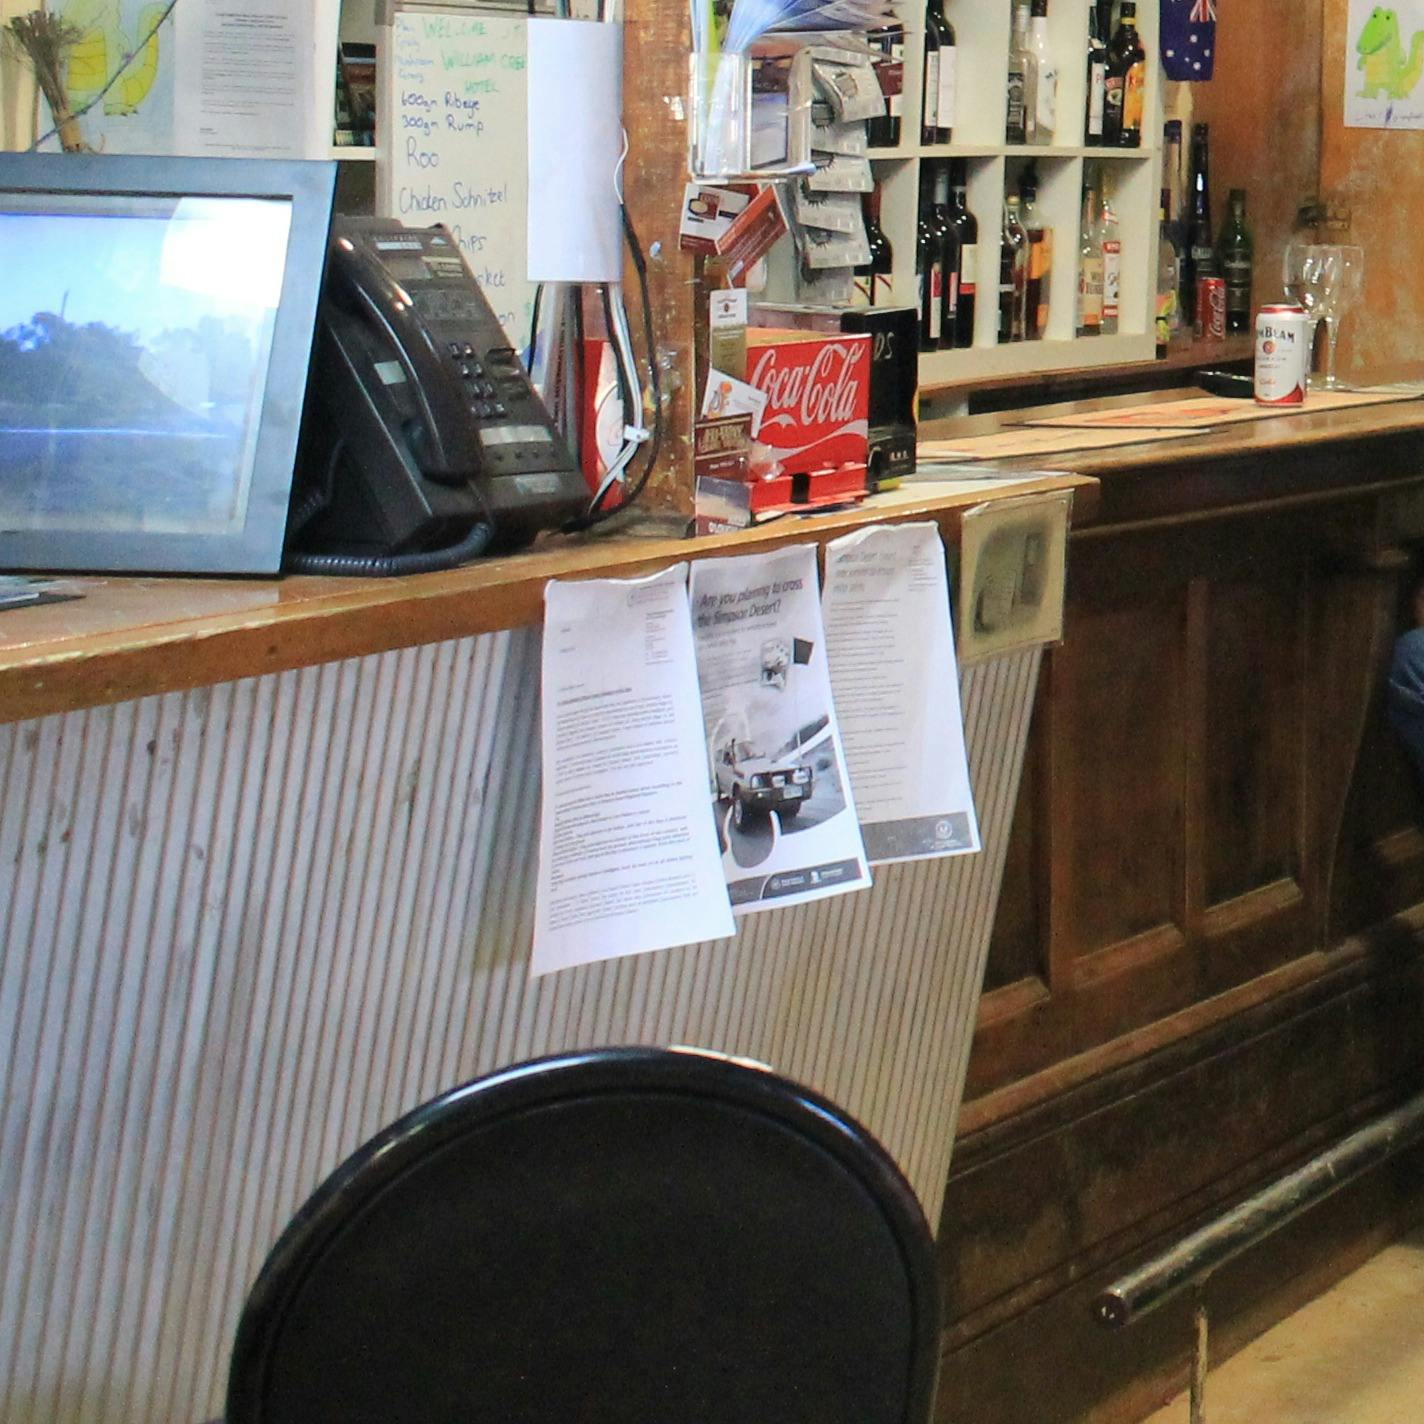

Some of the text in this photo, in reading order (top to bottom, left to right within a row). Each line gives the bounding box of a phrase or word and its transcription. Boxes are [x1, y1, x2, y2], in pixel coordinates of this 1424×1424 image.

[445, 91, 480, 119] Ribeye
[446, 114, 484, 137] Rump
[406, 136, 440, 169] Roo
[400, 181, 508, 215] Chicken Schnitzel
[699, 578, 804, 608] Are you planning to cross
[712, 608, 748, 625] Simpson
[750, 599, 782, 618] Desert?
